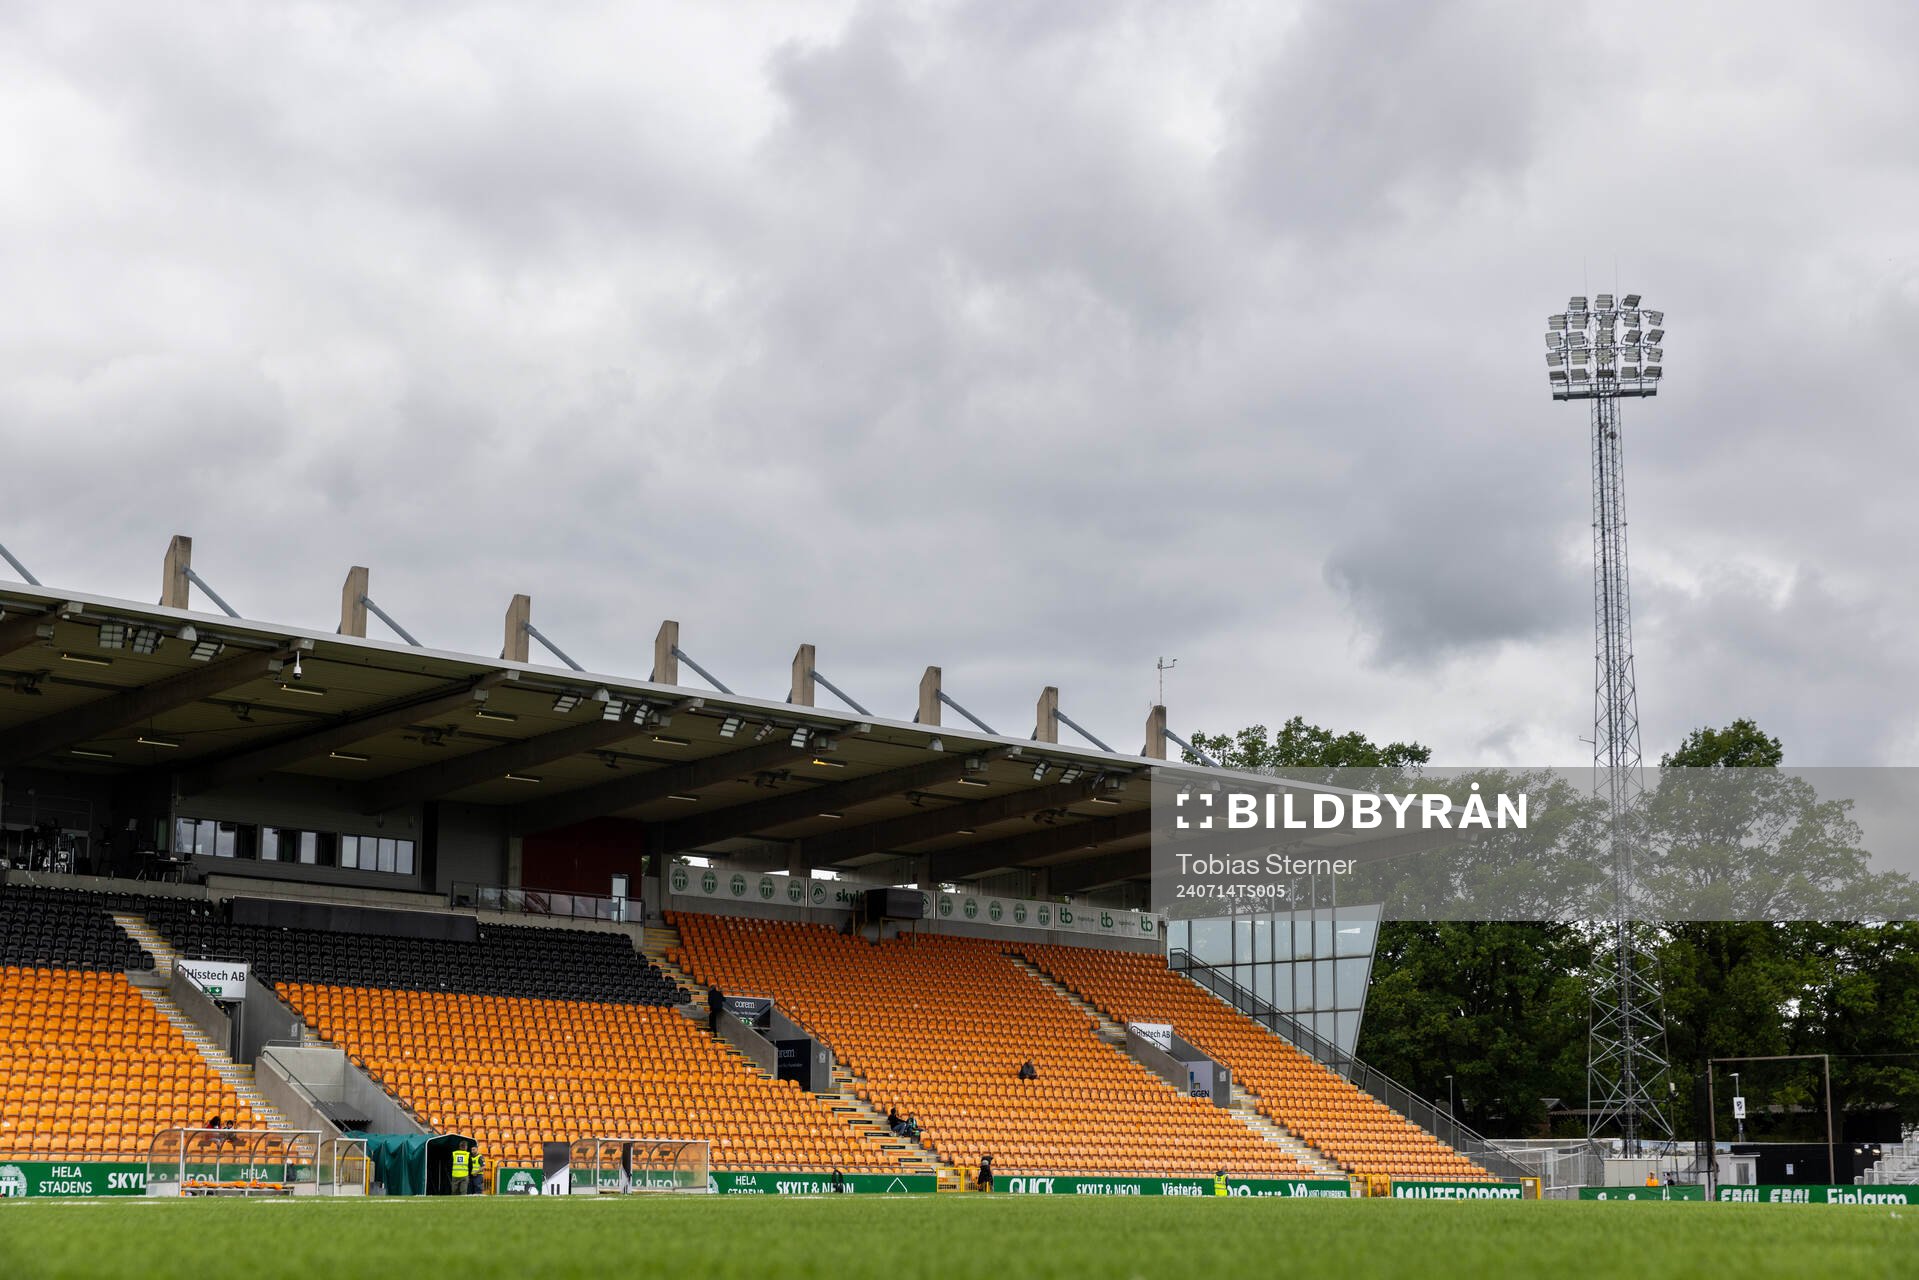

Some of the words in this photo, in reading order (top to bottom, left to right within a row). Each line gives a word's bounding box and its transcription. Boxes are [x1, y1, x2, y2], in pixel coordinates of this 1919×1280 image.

[186, 968, 229, 981] Hisstech
[230, 971, 246, 982] AB
[51, 1166, 82, 1178] HELA
[240, 1168, 269, 1179] HELA
[39, 1181, 93, 1193] STADENS
[735, 1176, 757, 1186] HELA
[1162, 1182, 1203, 1197] Västerås
